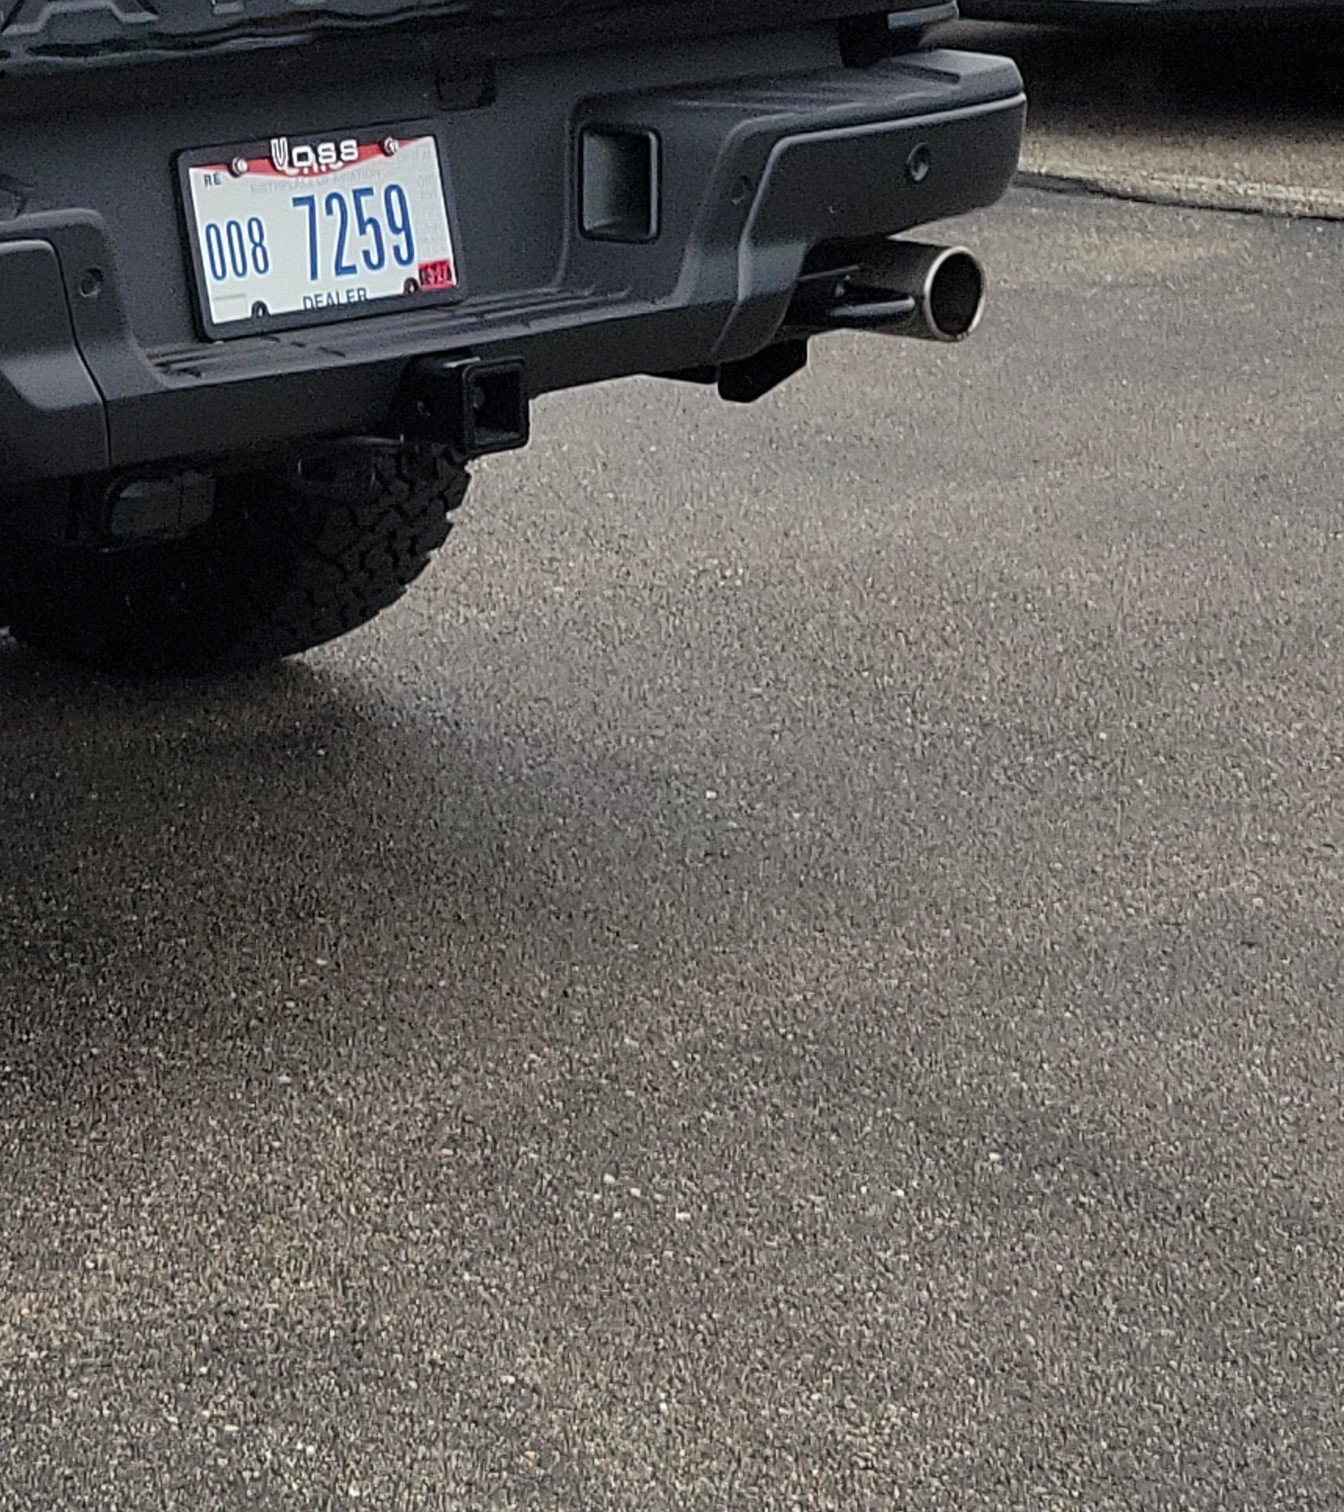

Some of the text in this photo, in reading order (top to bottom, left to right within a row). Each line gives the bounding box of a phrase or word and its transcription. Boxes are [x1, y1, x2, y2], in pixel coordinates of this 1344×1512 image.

[270, 136, 359, 171] Voss
[205, 216, 270, 281] 008
[291, 183, 416, 282] 7259
[302, 287, 370, 311] DEALER
